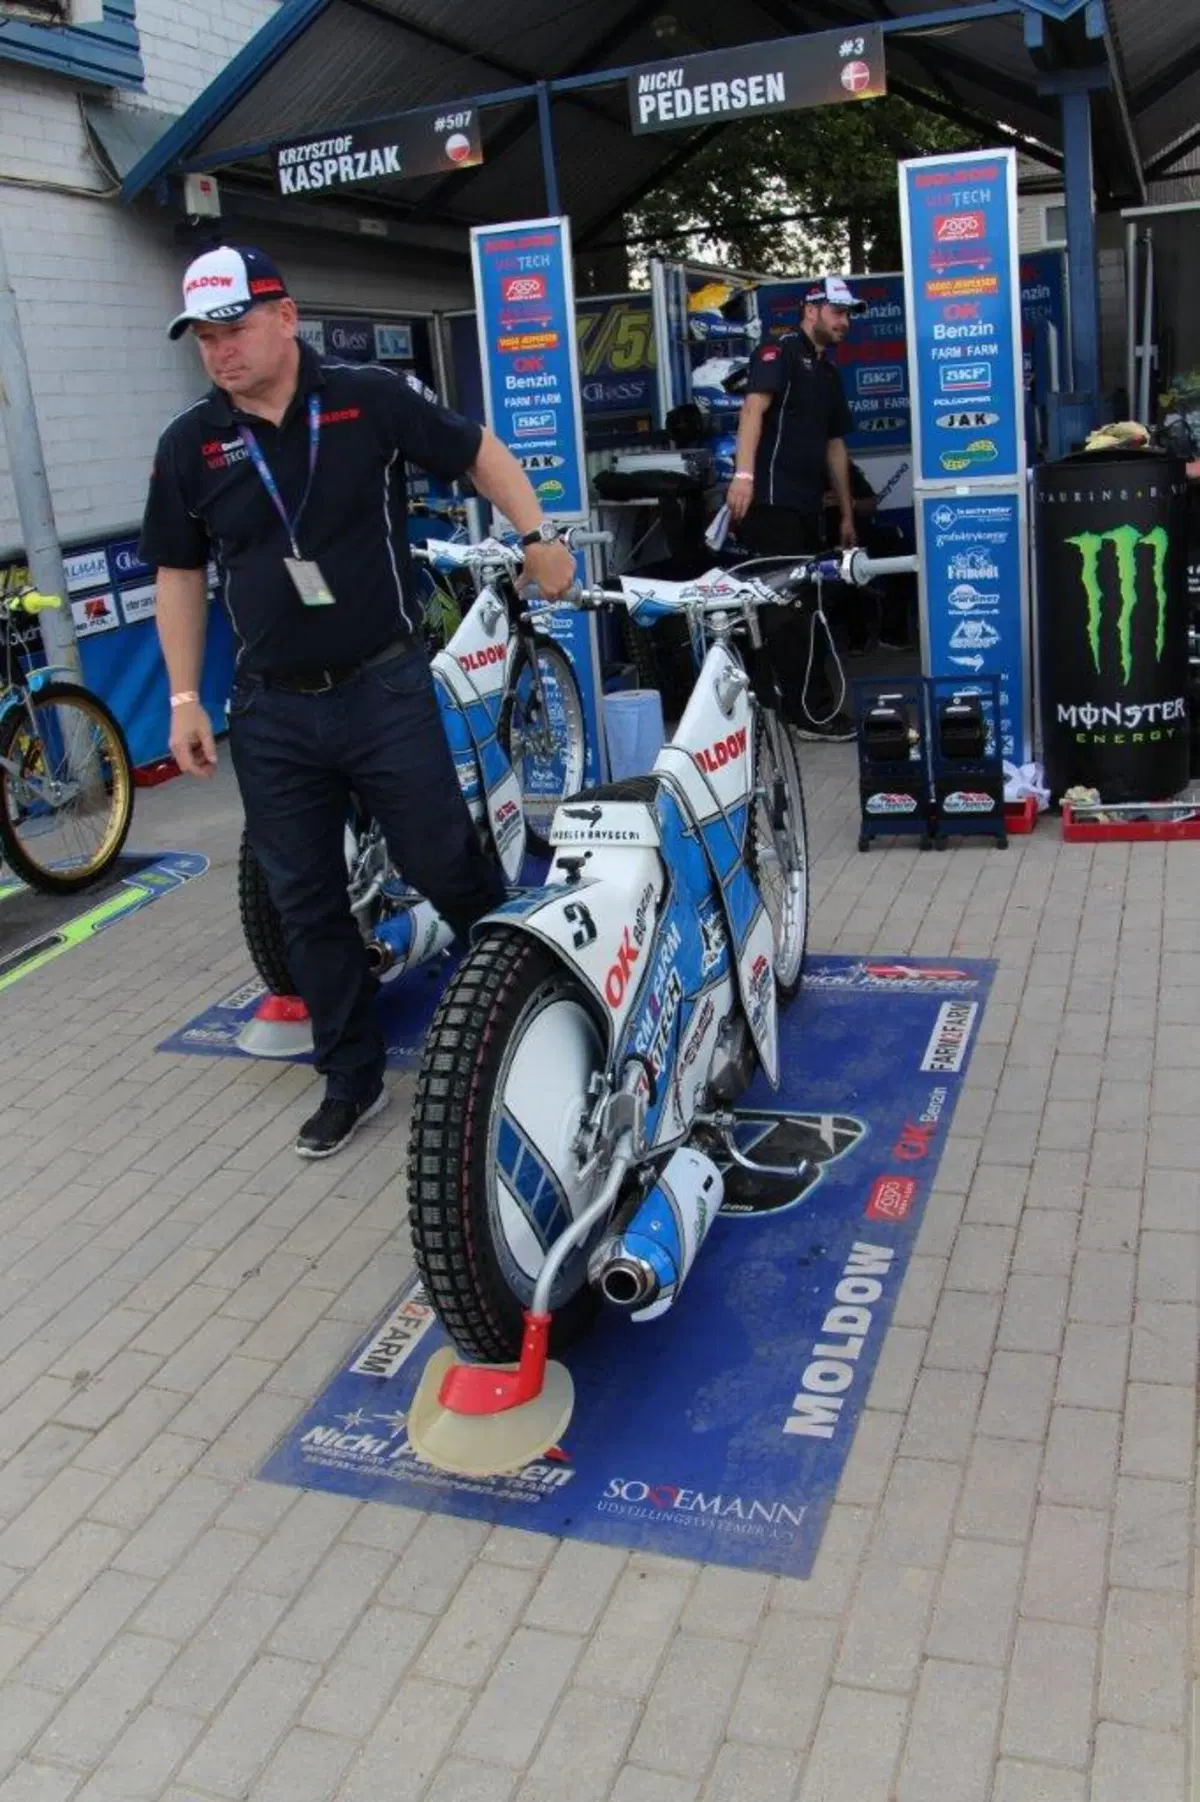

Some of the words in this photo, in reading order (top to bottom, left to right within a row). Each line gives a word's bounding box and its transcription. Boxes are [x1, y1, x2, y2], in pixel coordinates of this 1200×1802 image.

[838, 38, 865, 57] #3
[638, 68, 684, 93] NICKI
[638, 72, 786, 124] PEDERSEN
[434, 110, 472, 132] #507
[278, 136, 353, 166] KRZYSZTOF
[279, 145, 401, 195] KASPRZAK
[933, 321, 994, 340] Benzin
[505, 373, 556, 390] Benzin
[945, 367, 985, 382] SKF
[517, 415, 550, 428] SKF
[947, 412, 987, 427] JAK
[1057, 698, 1186, 730] MONSTER
[1076, 728, 1177, 745] ENERGY
[563, 900, 597, 950] 3
[606, 925, 640, 1009] OK
[919, 1086, 948, 1124] Benzin
[782, 1241, 895, 1439] MOLDOW
[300, 1425, 390, 1454] Nicki
